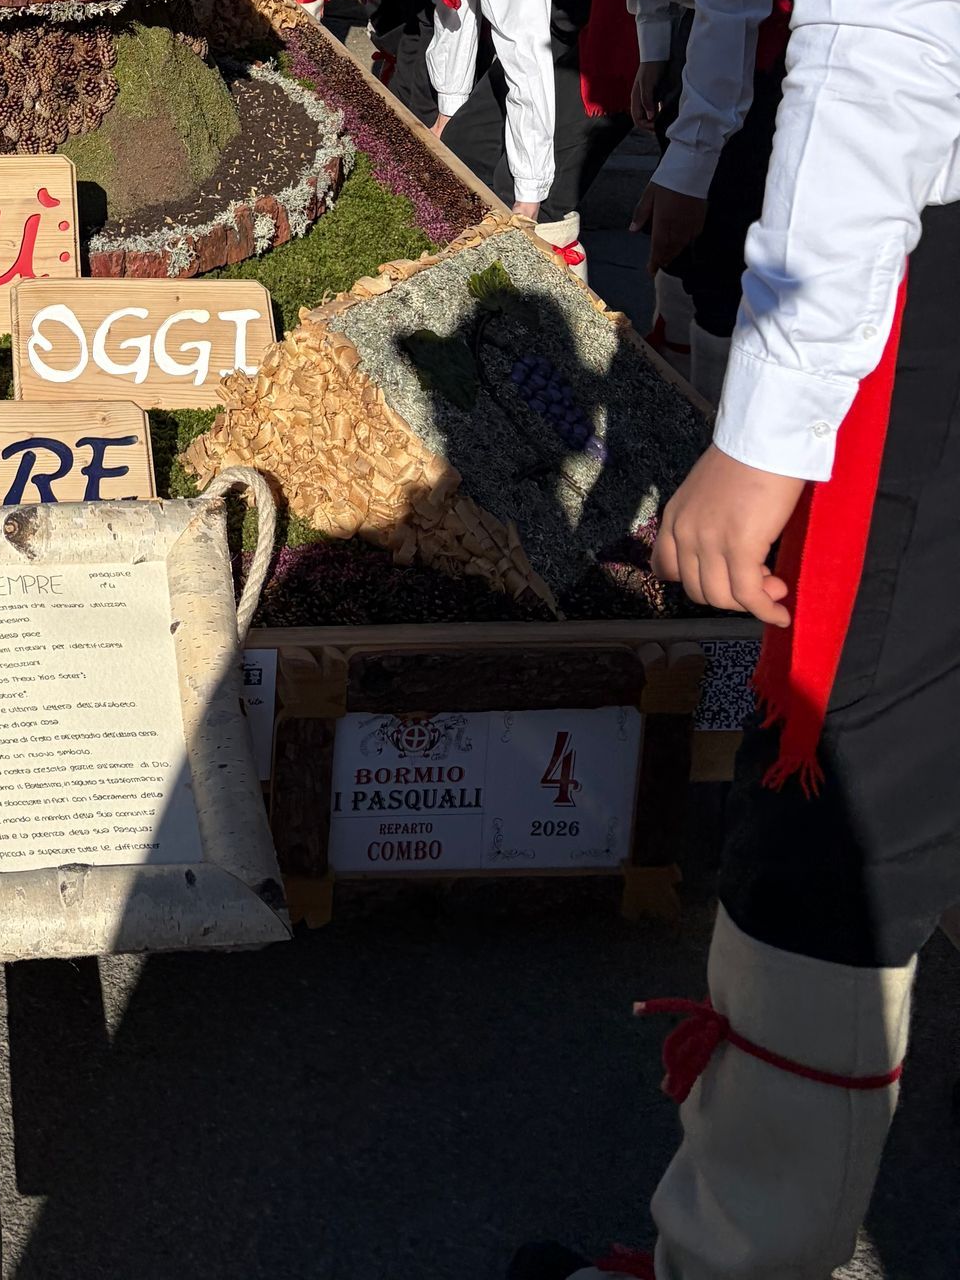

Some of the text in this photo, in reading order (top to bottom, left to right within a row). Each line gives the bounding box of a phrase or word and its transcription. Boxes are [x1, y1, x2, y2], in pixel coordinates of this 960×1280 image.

[27, 303, 262, 386] OGGI
[87, 570, 131, 579] pasquale
[50, 643, 65, 651] per
[28, 734, 52, 743] Cristo
[26, 750, 55, 758] nuovo
[2, 767, 31, 776] nostra
[539, 731, 583, 808] 4
[354, 765, 465, 786] BORMIO
[70, 795, 88, 803] con
[333, 787, 483, 812] I PASQUALI
[1, 815, 32, 824] mondo
[379, 822, 434, 836] REPARTO
[530, 820, 580, 837] 2026
[99, 843, 112, 852] le
[367, 839, 443, 862] COMBO
